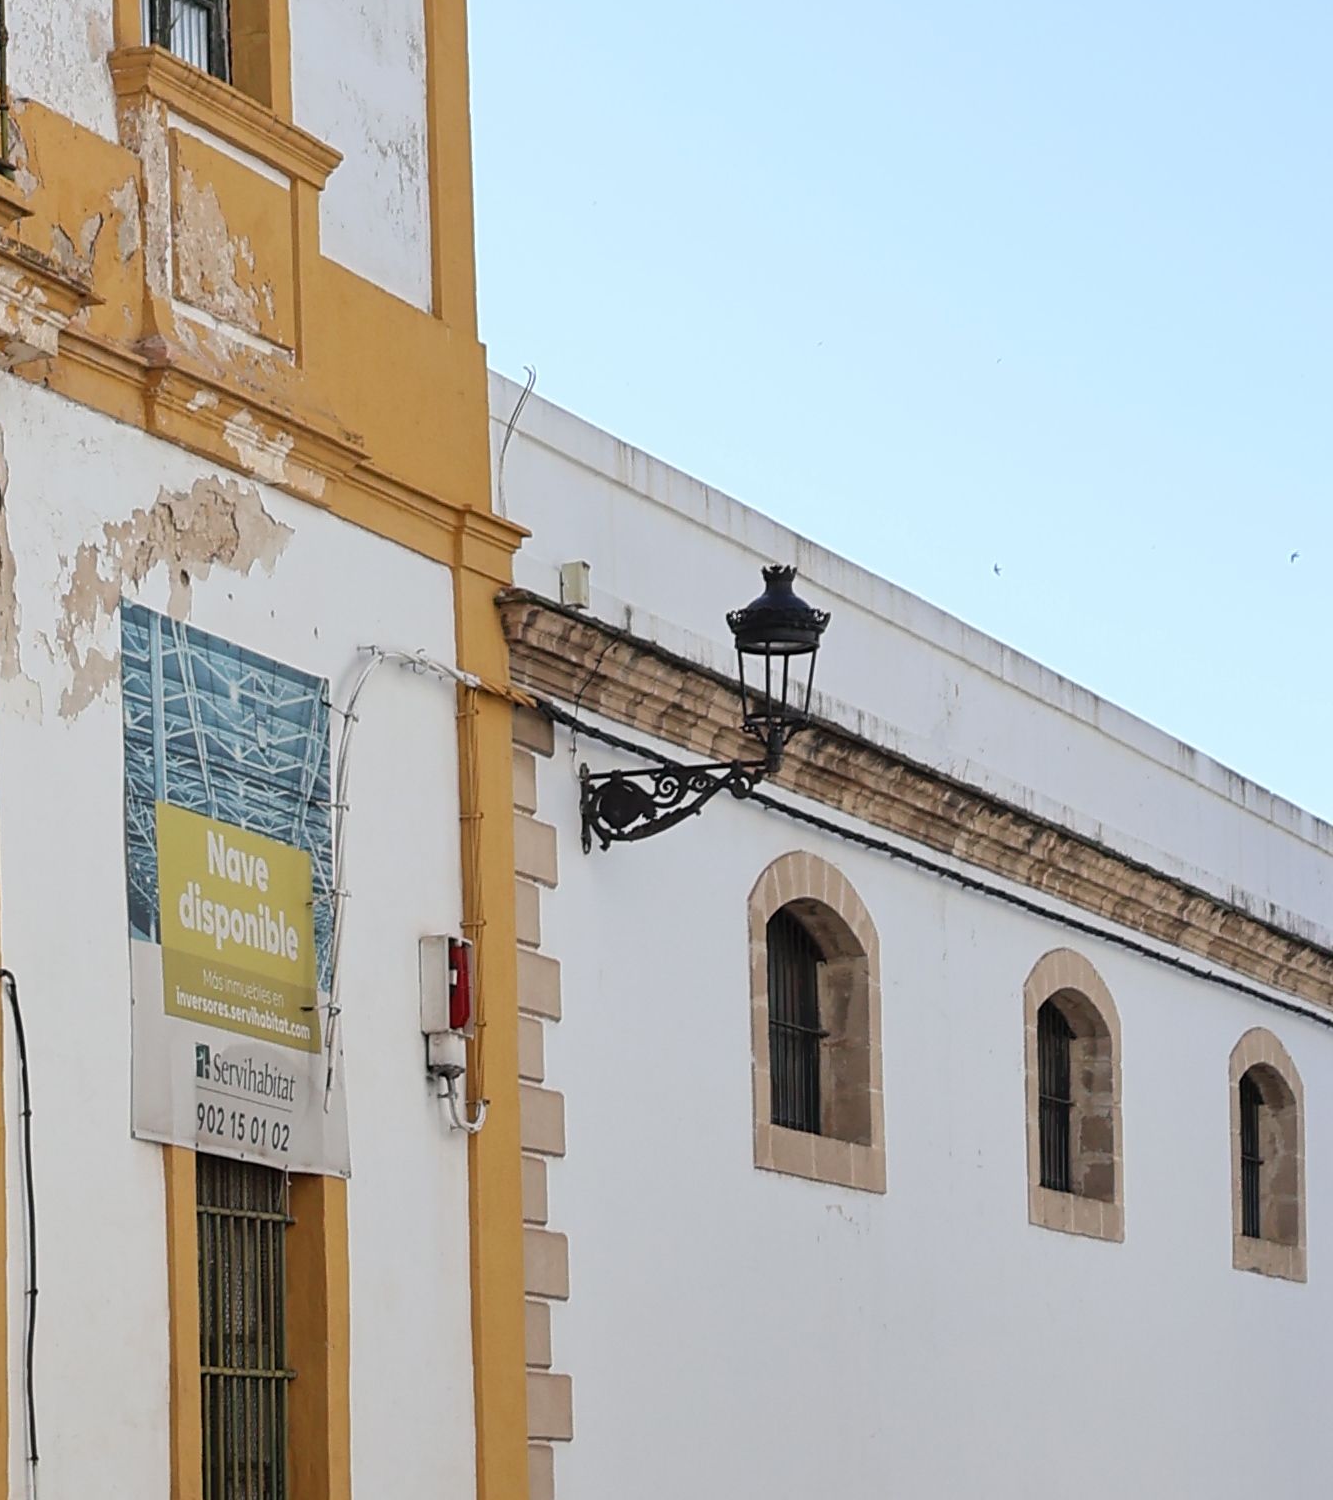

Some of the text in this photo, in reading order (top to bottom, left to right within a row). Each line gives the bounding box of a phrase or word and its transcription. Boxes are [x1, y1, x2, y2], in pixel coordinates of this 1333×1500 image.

[207, 830, 269, 892] Nave
[179, 880, 299, 961] disponible
[175, 985, 311, 1040] inversores.servihabitat.com
[213, 1052, 296, 1102] Servihabitat
[196, 1102, 290, 1152] 902 15 01 02
